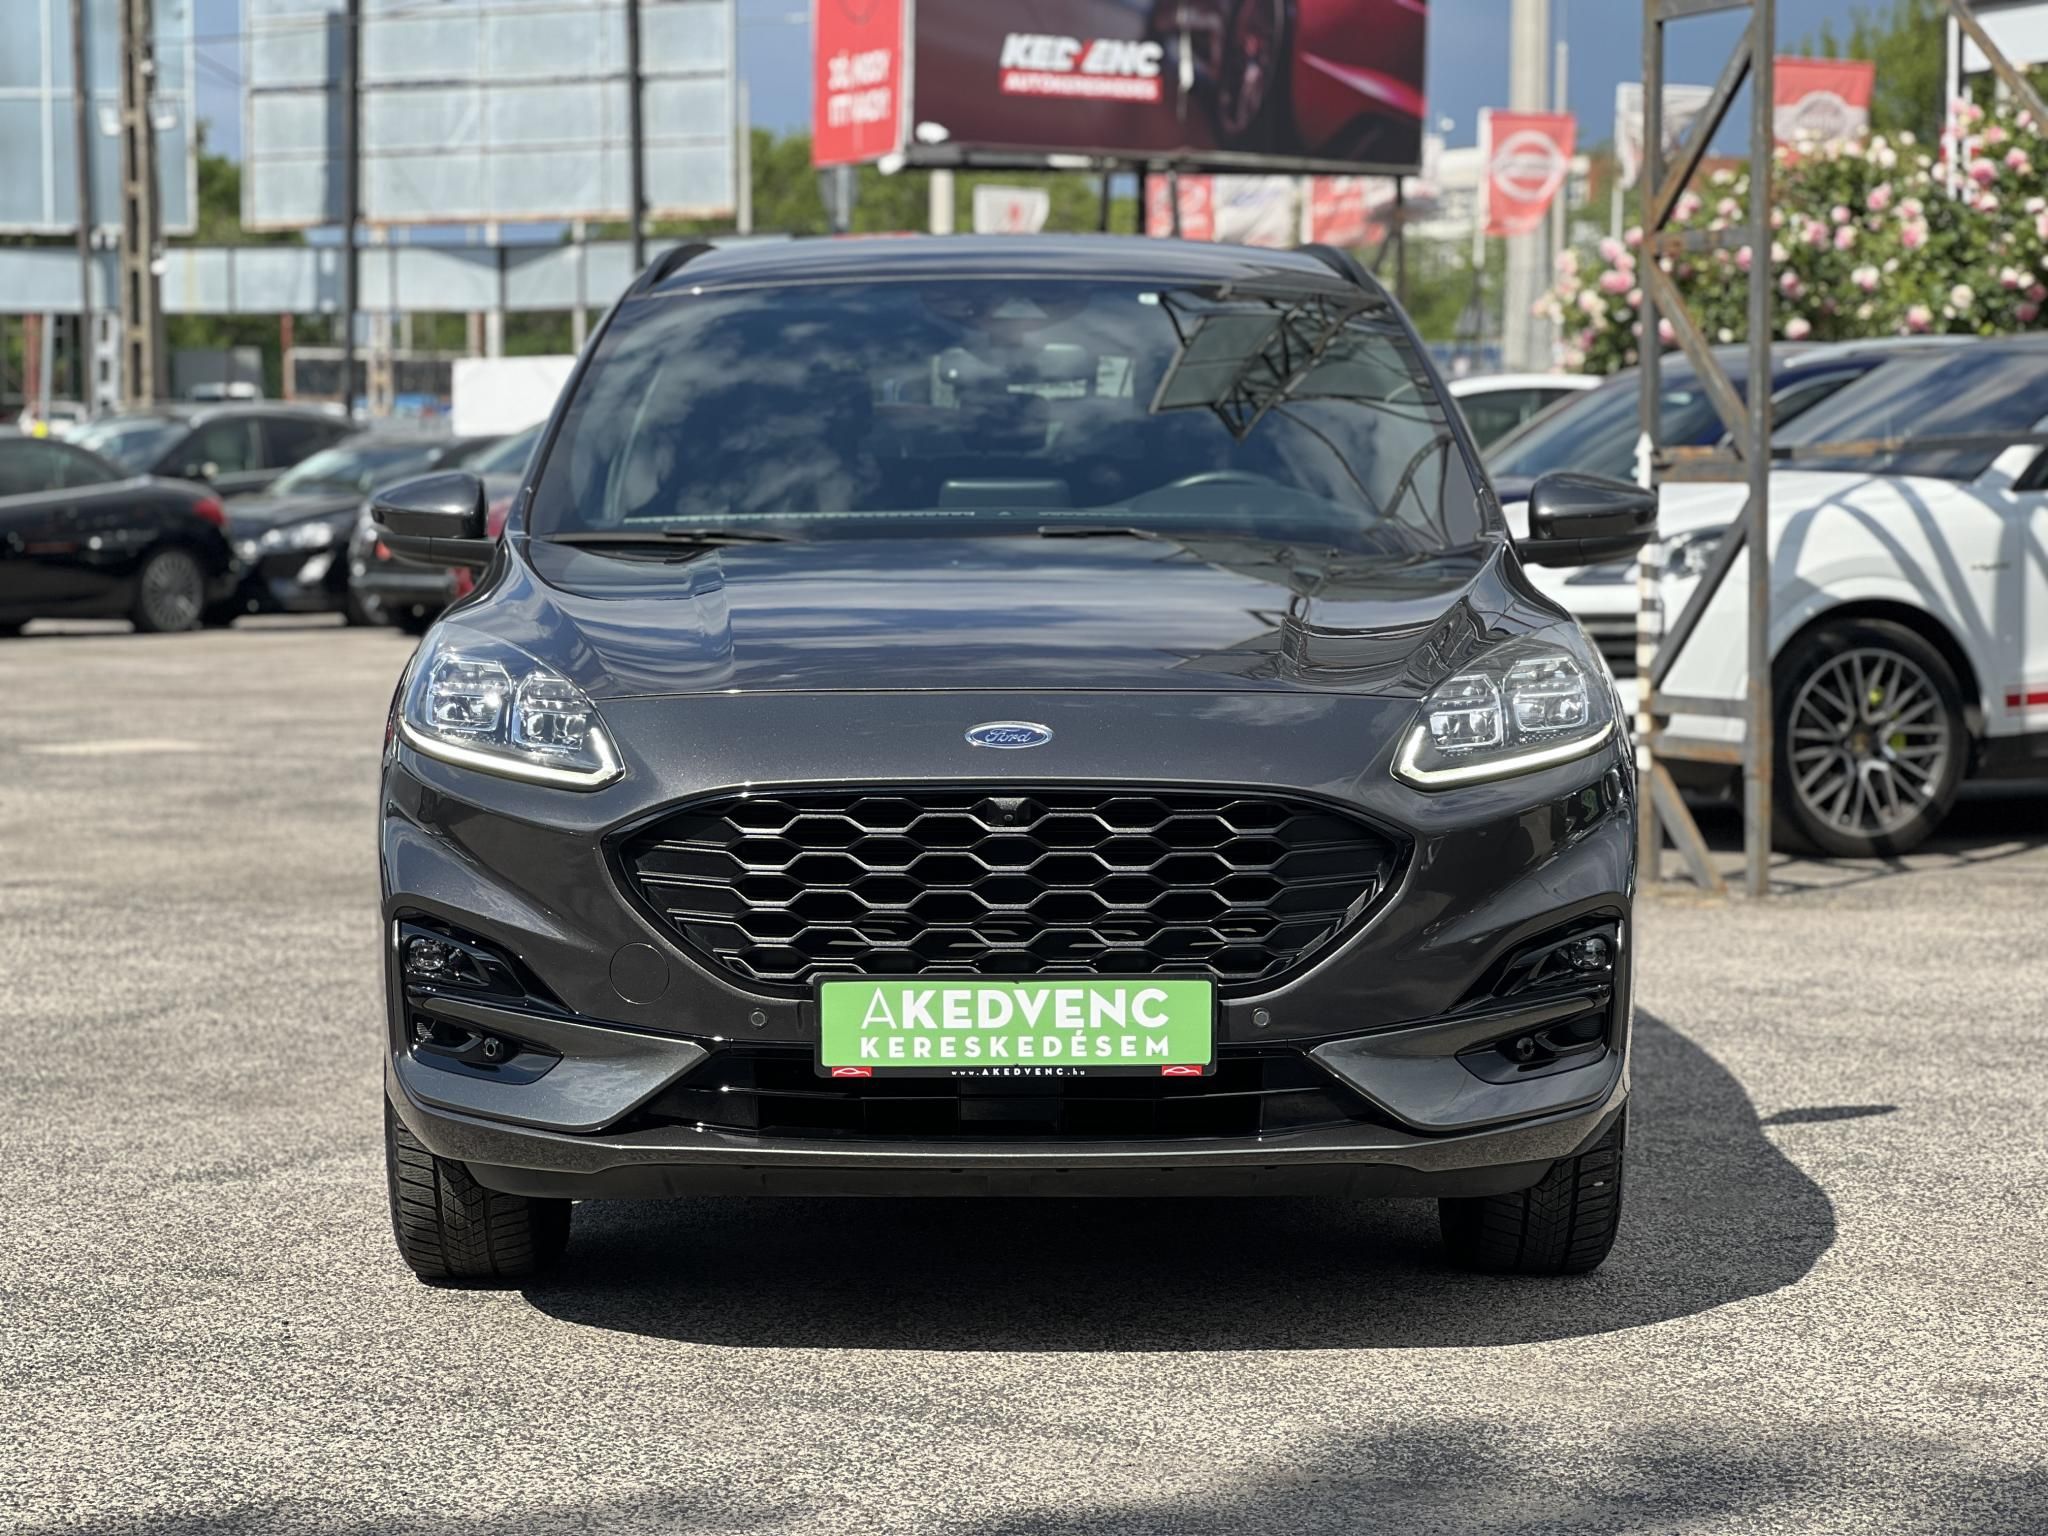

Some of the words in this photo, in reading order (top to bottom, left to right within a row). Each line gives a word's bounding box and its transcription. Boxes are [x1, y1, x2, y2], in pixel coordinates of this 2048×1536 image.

[984, 728, 1032, 743] Ford
[861, 1030, 1169, 1059] KERESKEDÉSEM
[951, 1067, 1086, 1076] www.AKEDVENC.hu
